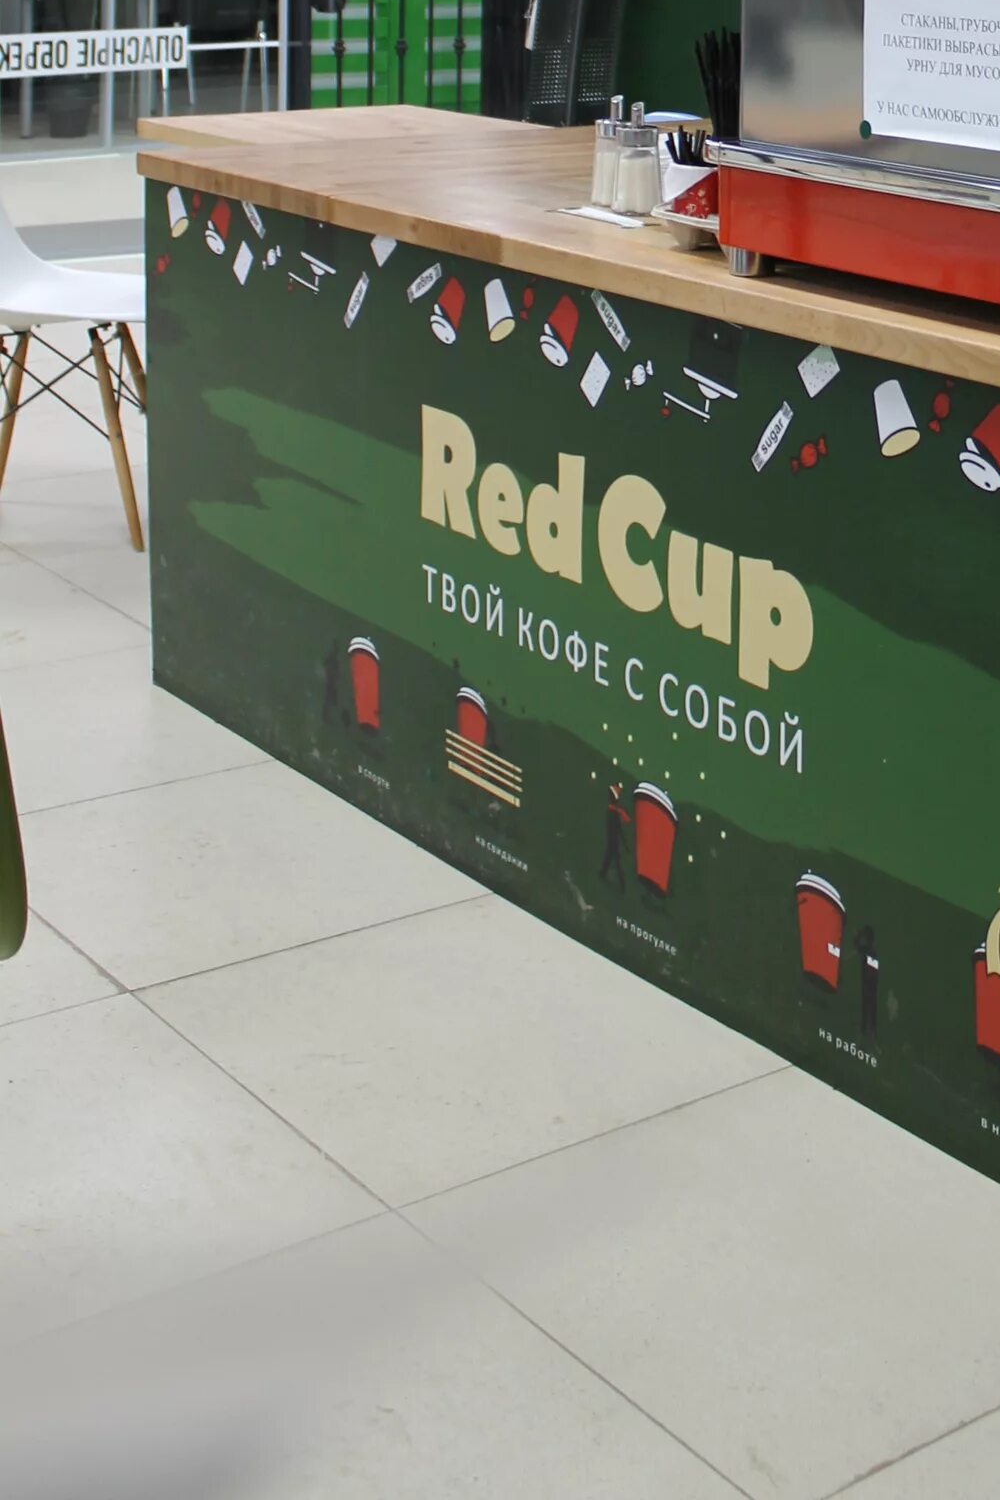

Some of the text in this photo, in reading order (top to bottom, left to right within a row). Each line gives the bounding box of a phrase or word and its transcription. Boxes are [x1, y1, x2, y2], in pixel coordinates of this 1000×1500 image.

[882, 34, 942, 51] ПАКЕТИКИ
[906, 59, 936, 73] УРНУ
[939, 63, 963, 77] ДЛЯ
[877, 101, 887, 113] У
[887, 102, 911, 117] НАС
[599, 301, 622, 338] sugar
[760, 417, 785, 456] sugar
[420, 403, 815, 691] Red Cup
[421, 563, 804, 775] ТВОЙ КОФЕ С СОБОЙ
[616, 915, 678, 957] на прогулке
[818, 1027, 879, 1069] на работе
[981, 1117, 989, 1129] в
